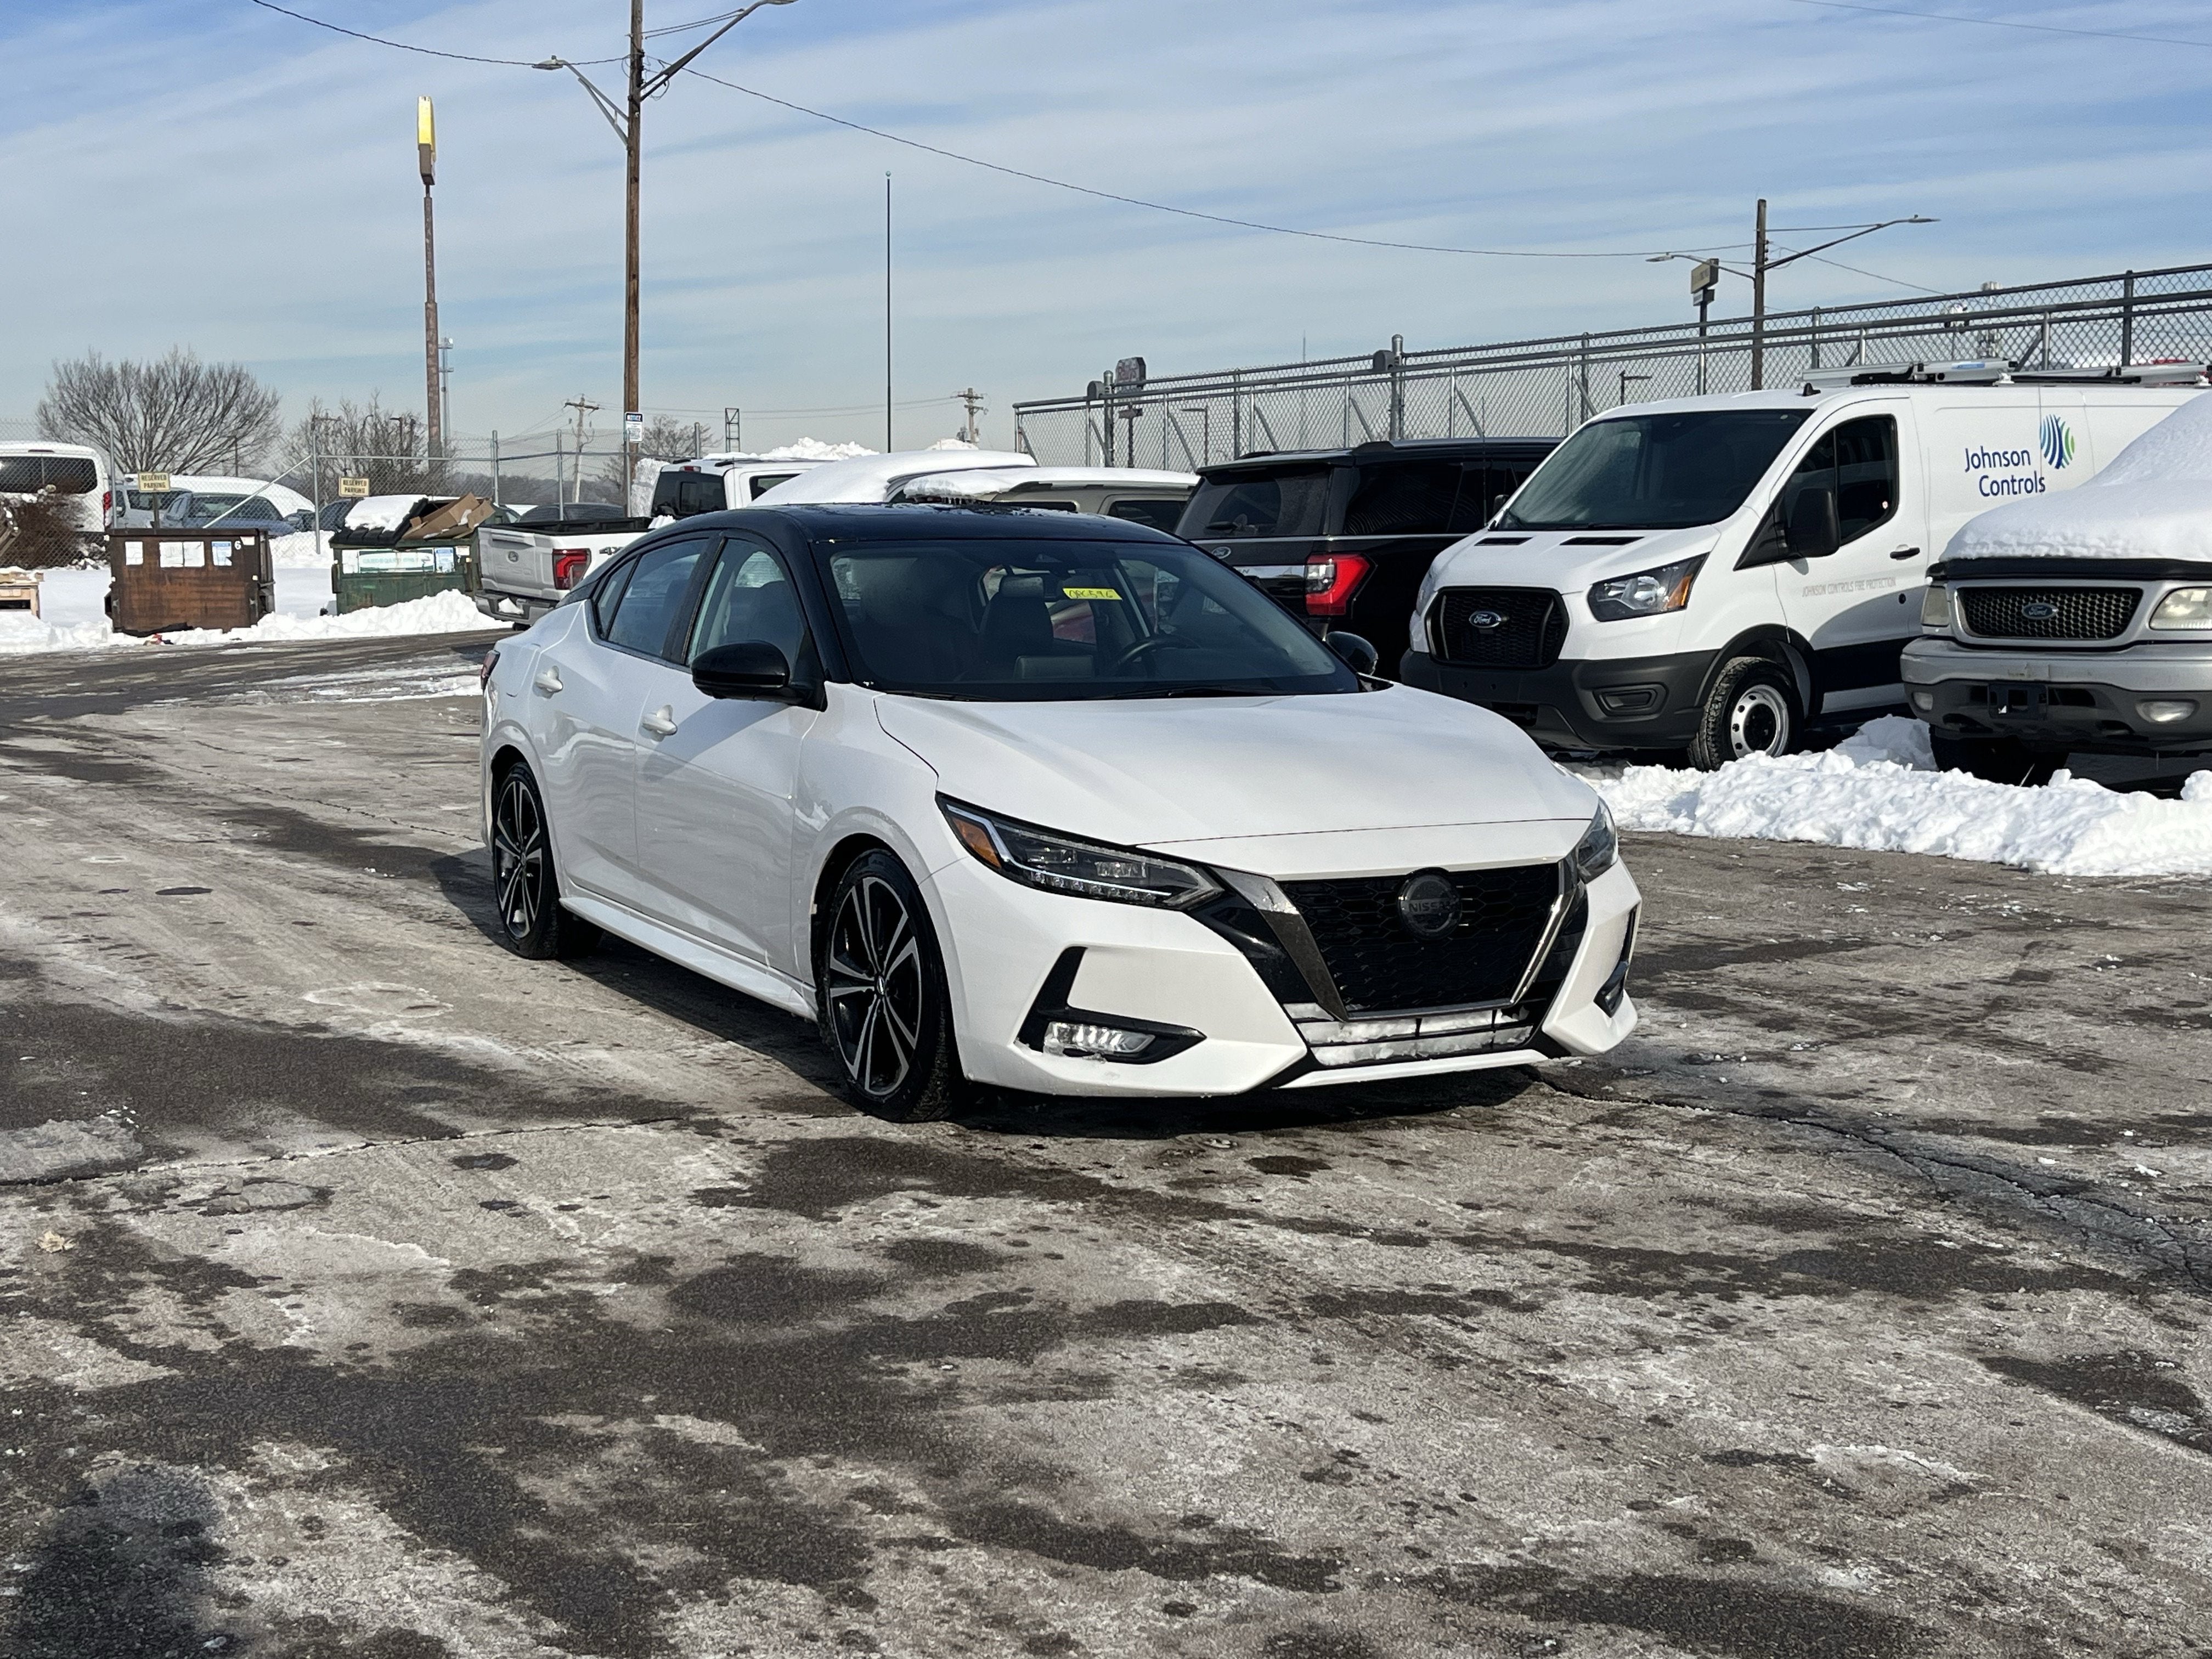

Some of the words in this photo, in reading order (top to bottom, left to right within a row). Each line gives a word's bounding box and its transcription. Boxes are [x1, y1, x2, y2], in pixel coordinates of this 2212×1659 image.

[1965, 445, 2031, 473] Johnson
[1979, 470, 2046, 497] Controls
[234, 540, 241, 550] 6
[1802, 584, 1826, 597] JOHNSON
[1827, 581, 1854, 595] CONTROLS
[1866, 577, 1897, 590] PROTECTION
[1474, 613, 1492, 624] Ford
